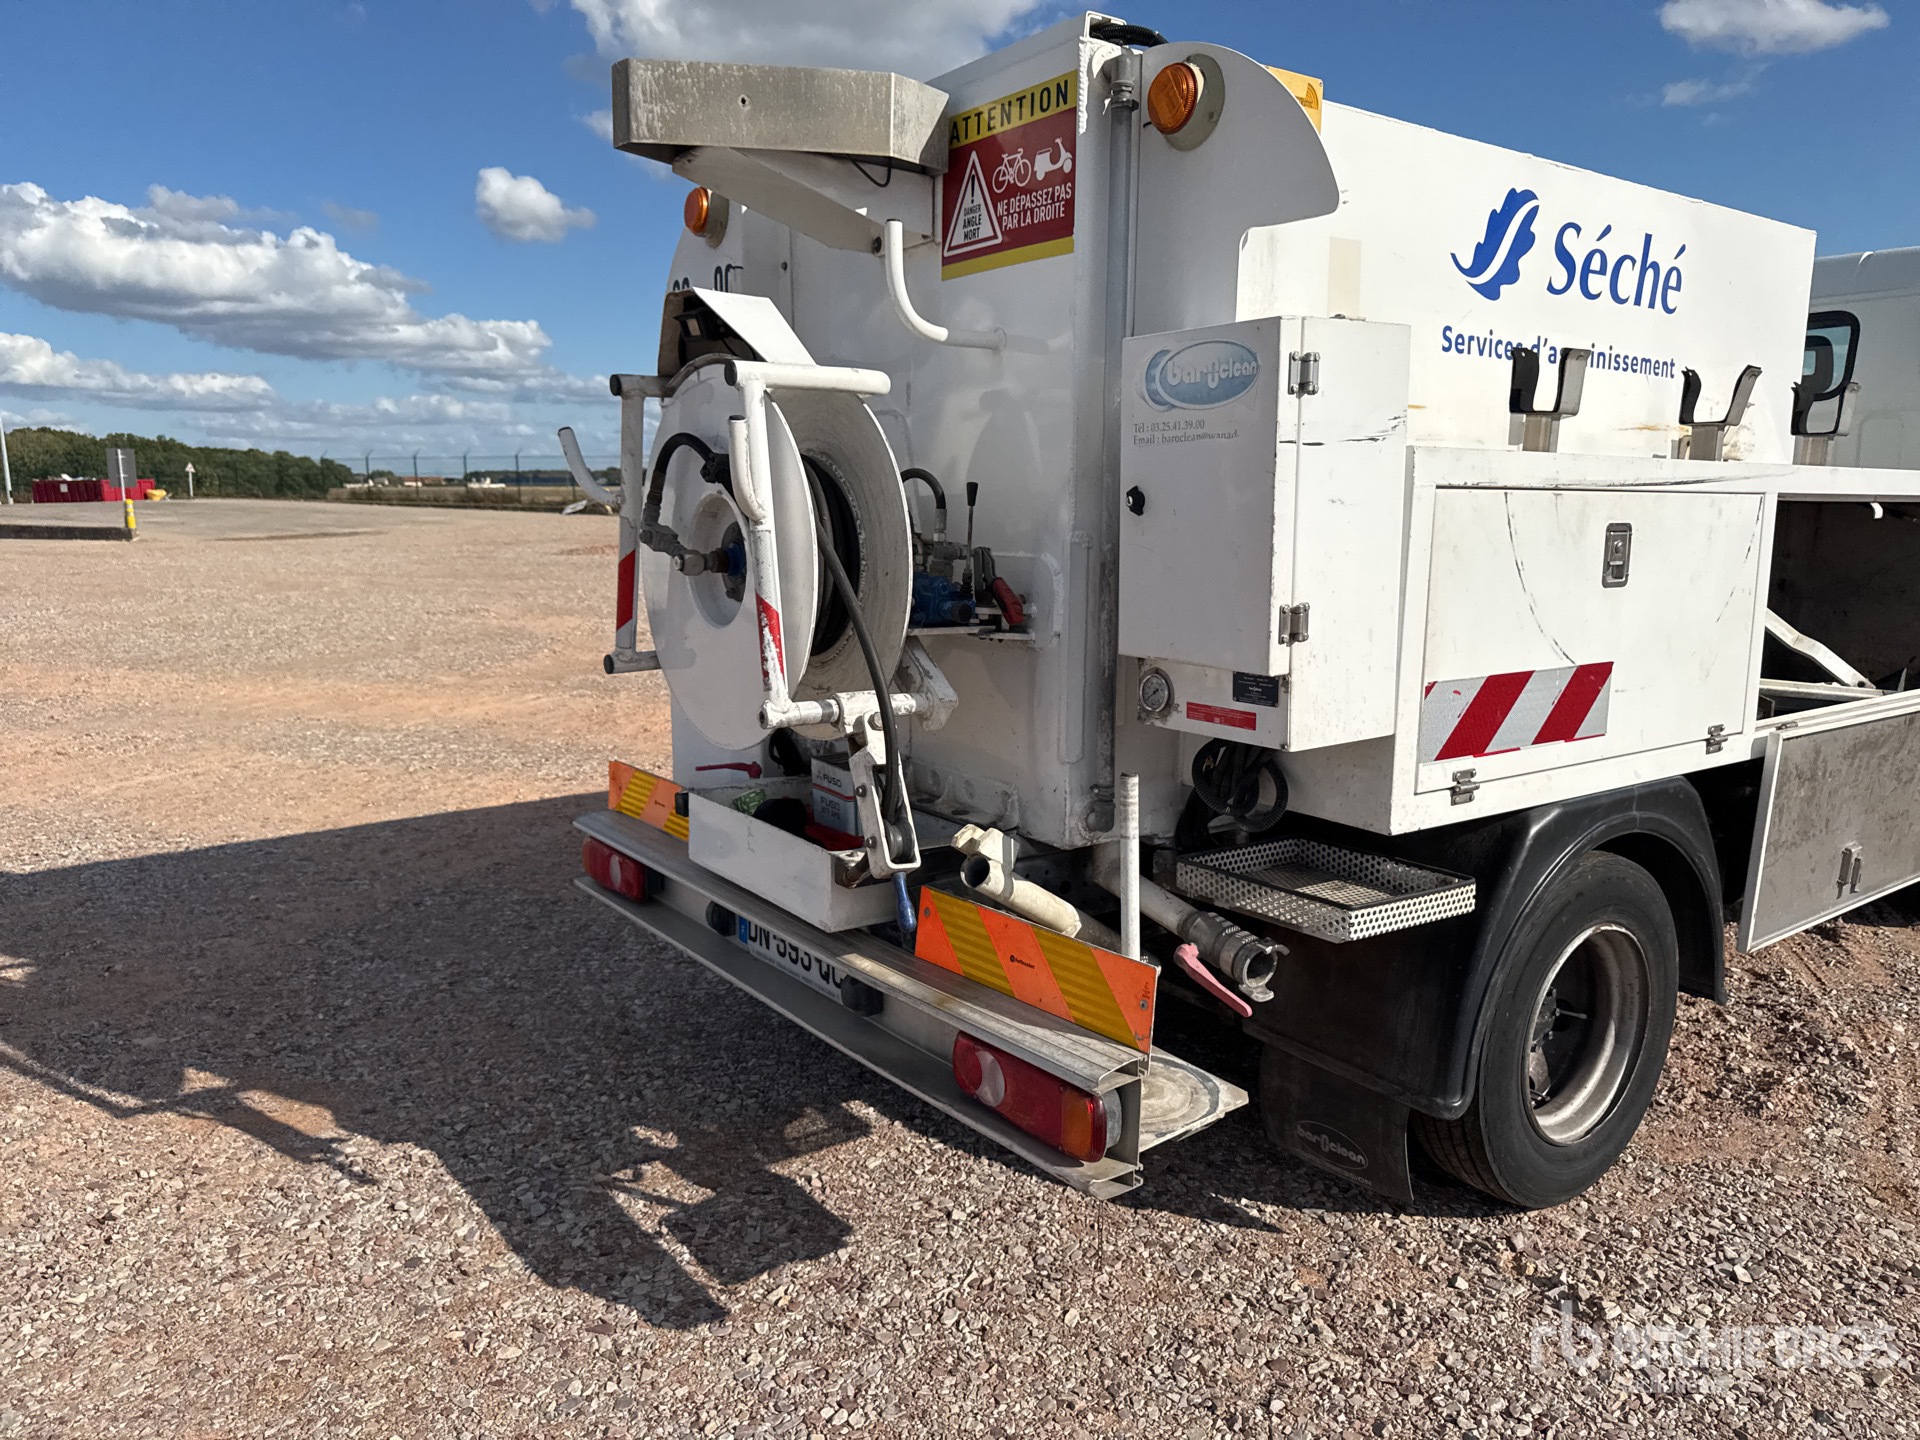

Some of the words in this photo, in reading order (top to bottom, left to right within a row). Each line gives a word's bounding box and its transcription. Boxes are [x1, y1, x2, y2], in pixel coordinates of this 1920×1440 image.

[950, 79, 1069, 146] ATTENTION
[997, 199, 1009, 218] NE
[1010, 187, 1053, 214] DÉPASSEZ
[1054, 182, 1072, 202] PAS
[963, 204, 982, 216] DANGER
[1002, 212, 1018, 231] PAR
[1020, 208, 1032, 227] LA
[1033, 201, 1065, 224] DROITE
[962, 214, 982, 230] ANGLE
[963, 227, 981, 242] MORT
[1546, 221, 1687, 315] Séché
[1150, 419, 1206, 433] 03.25.41.39.00
[1133, 433, 1156, 445] Email
[823, 773, 842, 788] FUSO
[820, 796, 840, 811] FUSO
